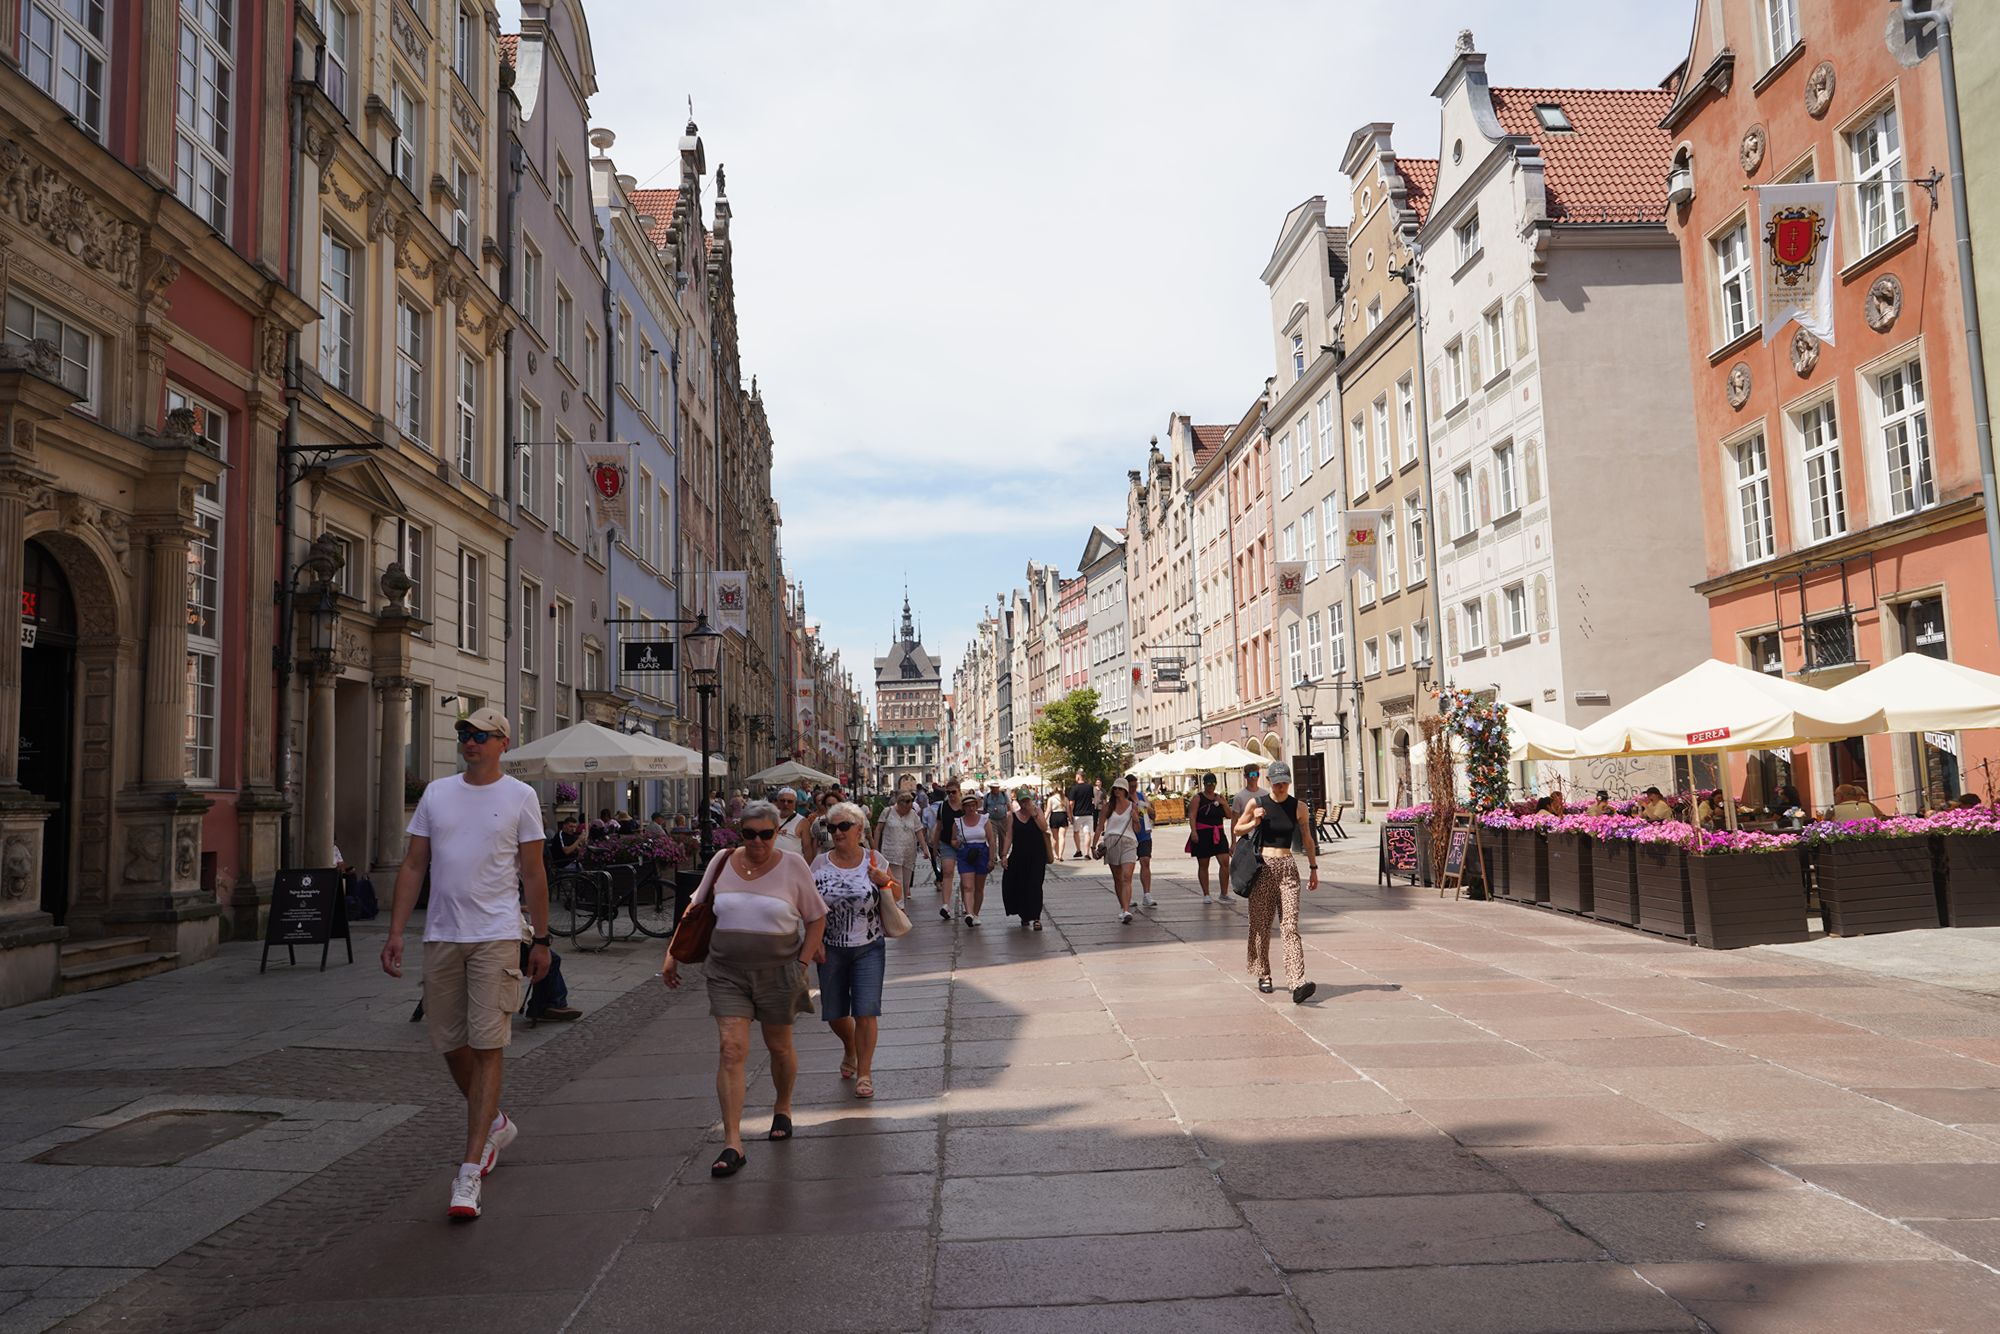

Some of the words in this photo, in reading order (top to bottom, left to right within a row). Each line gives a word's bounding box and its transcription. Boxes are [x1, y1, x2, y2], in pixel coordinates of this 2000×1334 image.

[21, 628, 35, 644] 35
[1691, 729, 1726, 743] PERŁA
[1453, 832, 1466, 845] BEER
